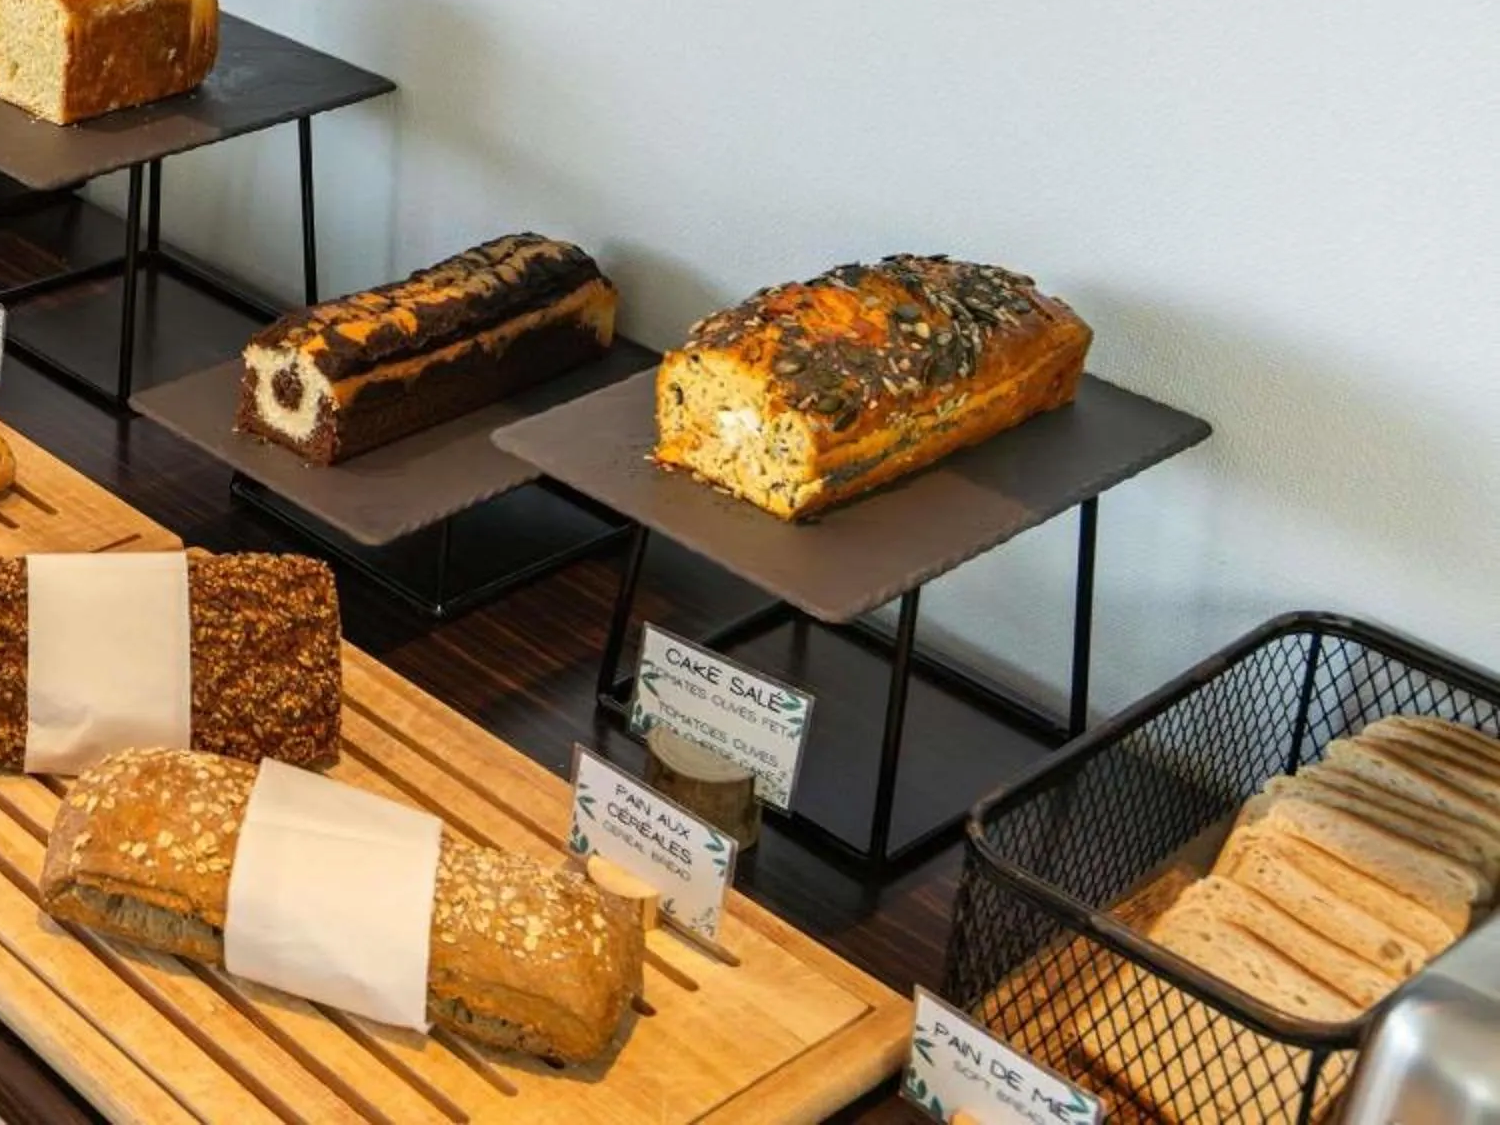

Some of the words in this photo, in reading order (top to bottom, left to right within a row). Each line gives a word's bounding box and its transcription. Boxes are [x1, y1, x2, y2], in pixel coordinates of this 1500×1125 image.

[665, 648, 723, 686] CAKE
[729, 676, 783, 714] SALÉ
[711, 694, 757, 724] OLIVES
[615, 784, 651, 816] PAIN
[657, 814, 691, 840] AUX
[934, 1022, 981, 1066] PAIN
[990, 1059, 1025, 1092] DE
